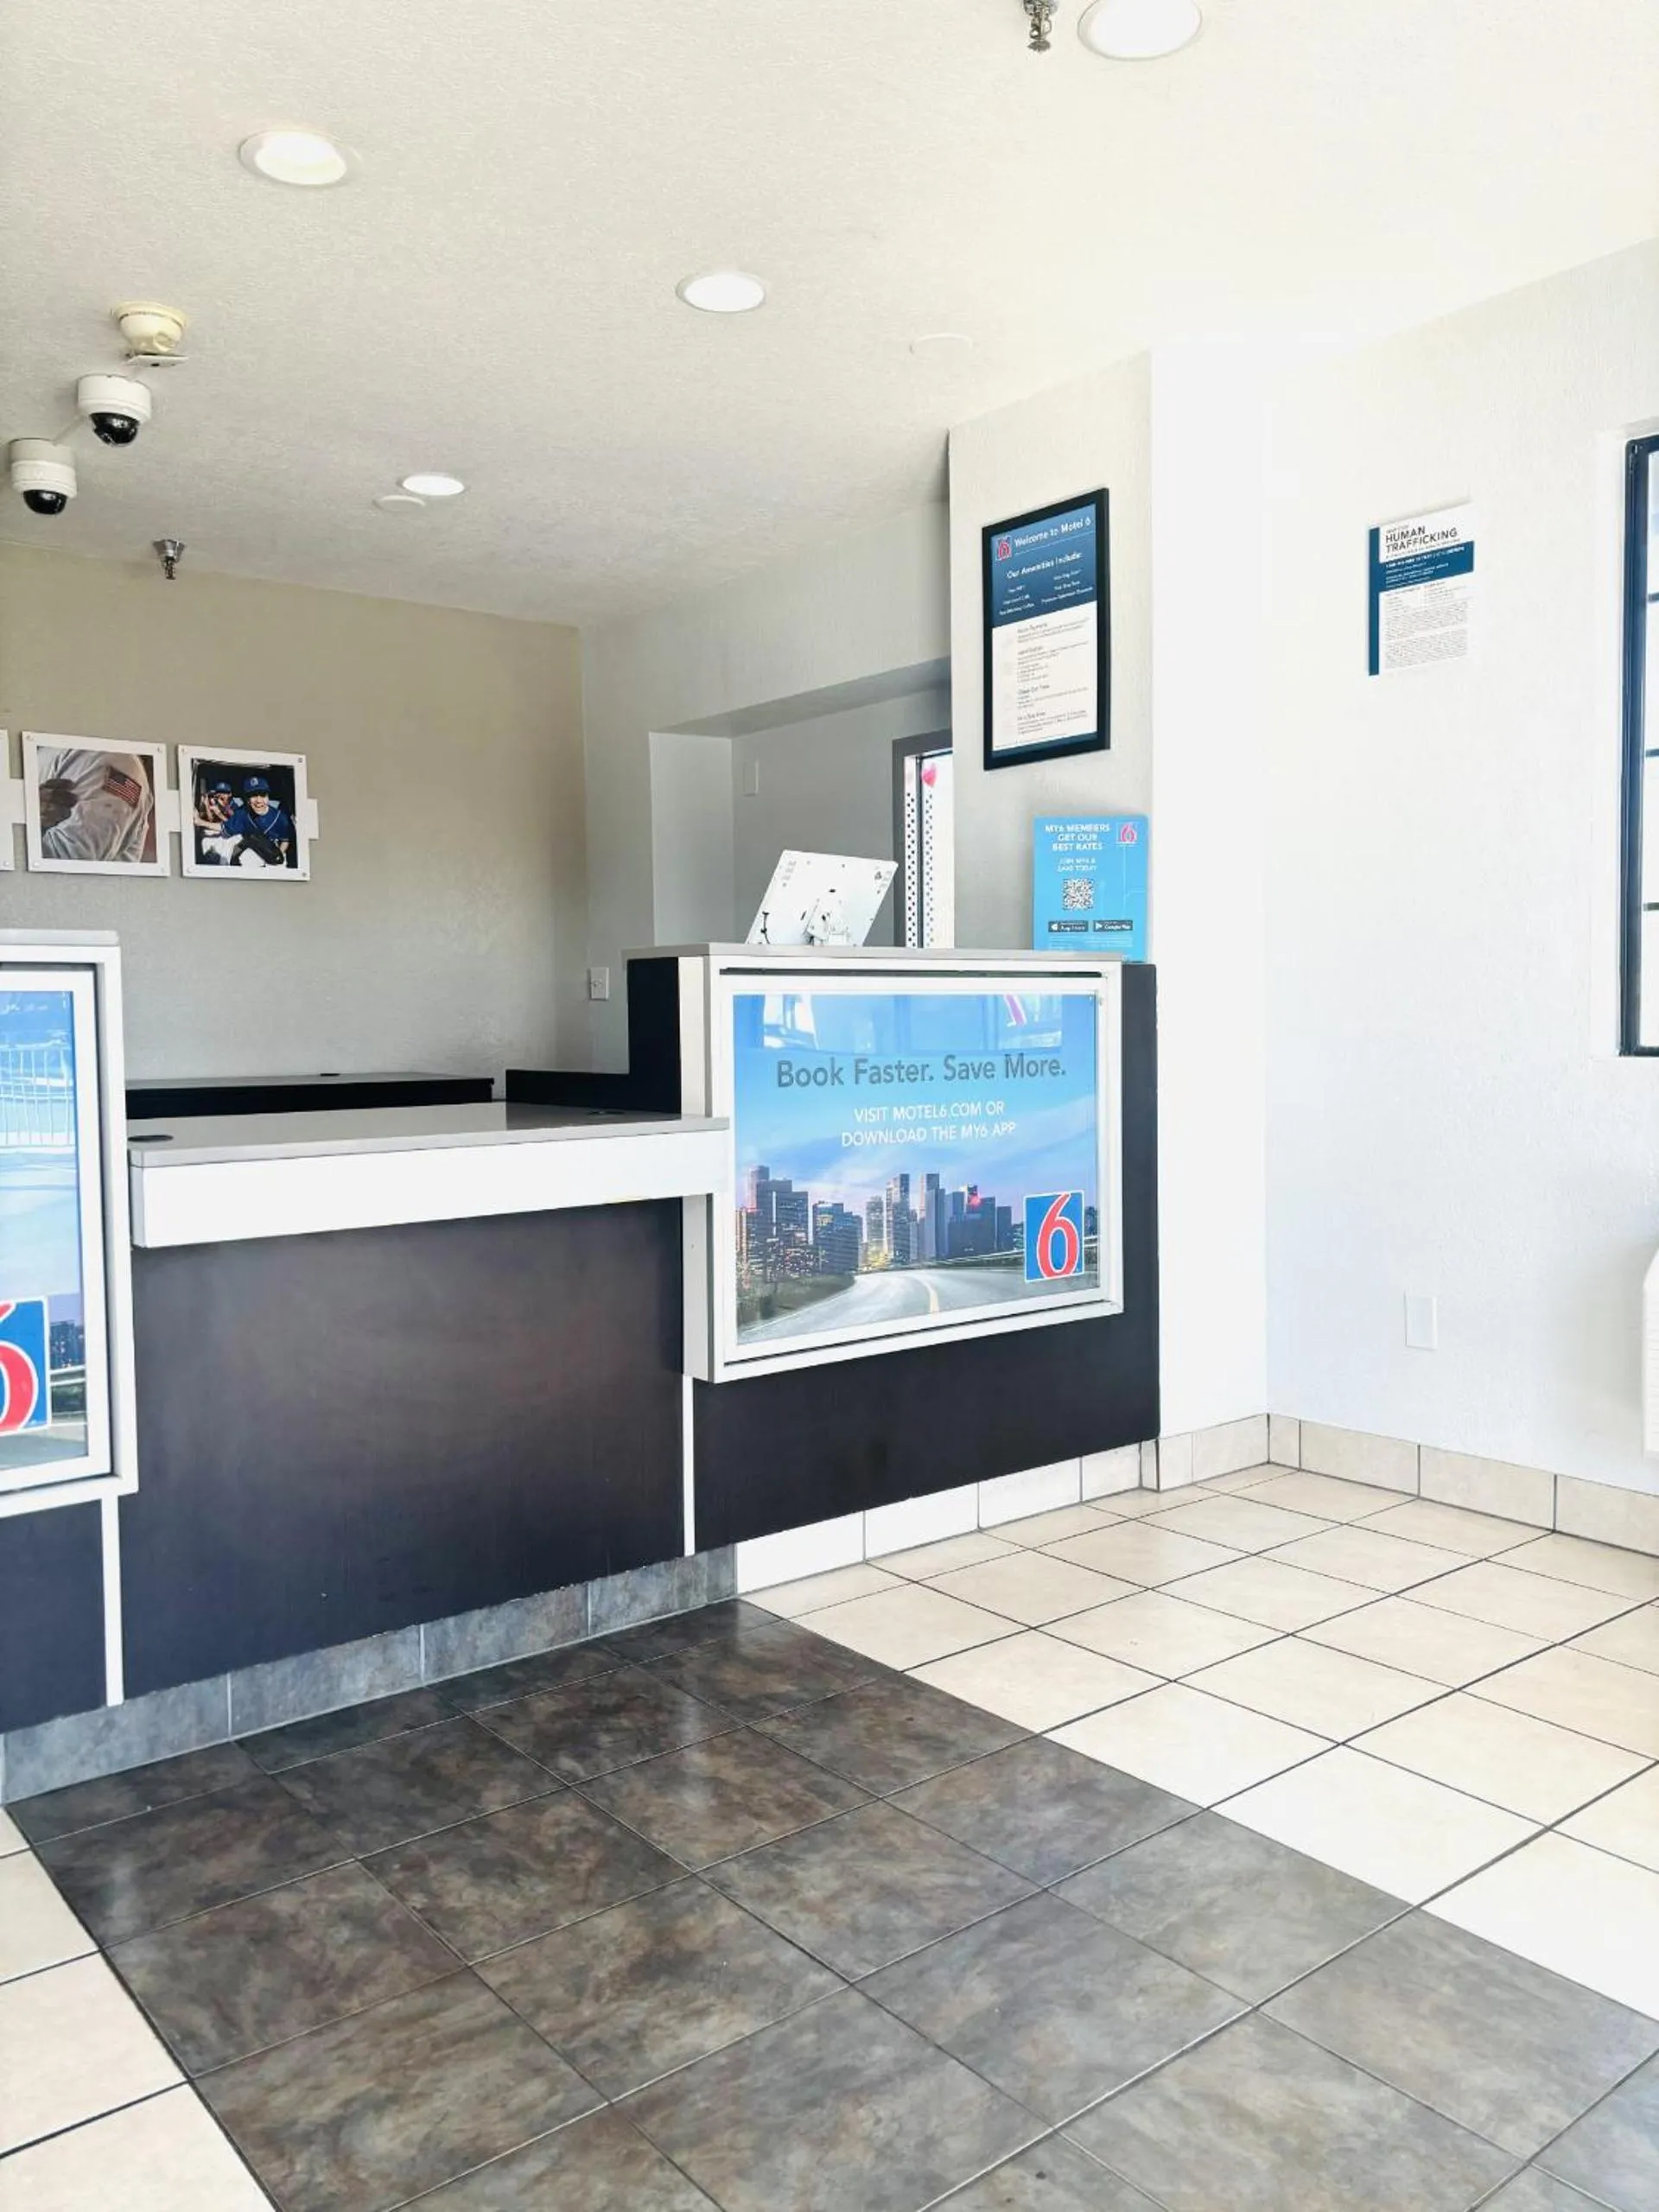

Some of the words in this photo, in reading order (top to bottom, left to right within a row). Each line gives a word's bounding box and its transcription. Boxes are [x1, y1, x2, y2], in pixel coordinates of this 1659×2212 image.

[1014, 531, 1048, 547] Welcome
[1050, 528, 1059, 537] to
[1061, 518, 1084, 533] Motel
[1085, 517, 1091, 526] 6
[1385, 525, 1426, 543] HUMAN
[1386, 527, 1458, 553] TRAFFICKING
[1077, 833, 1098, 842] OUR
[1120, 823, 1137, 843] 6
[1052, 842, 1075, 851] BEST
[1076, 842, 1103, 851] RATES
[778, 1056, 844, 1088] Book
[854, 1057, 934, 1085] Faster.
[943, 1053, 995, 1082] Save
[1004, 1052, 1066, 1079] More.
[854, 1106, 888, 1123] VISIT
[893, 1101, 982, 1122] MOTEL6.COM
[985, 1100, 1005, 1116] OR
[841, 1126, 927, 1147] DOWNLOAD
[931, 1125, 957, 1141] THE
[961, 1123, 988, 1141] MY6
[992, 1122, 1016, 1137] APP
[1037, 1192, 1079, 1279] 6
